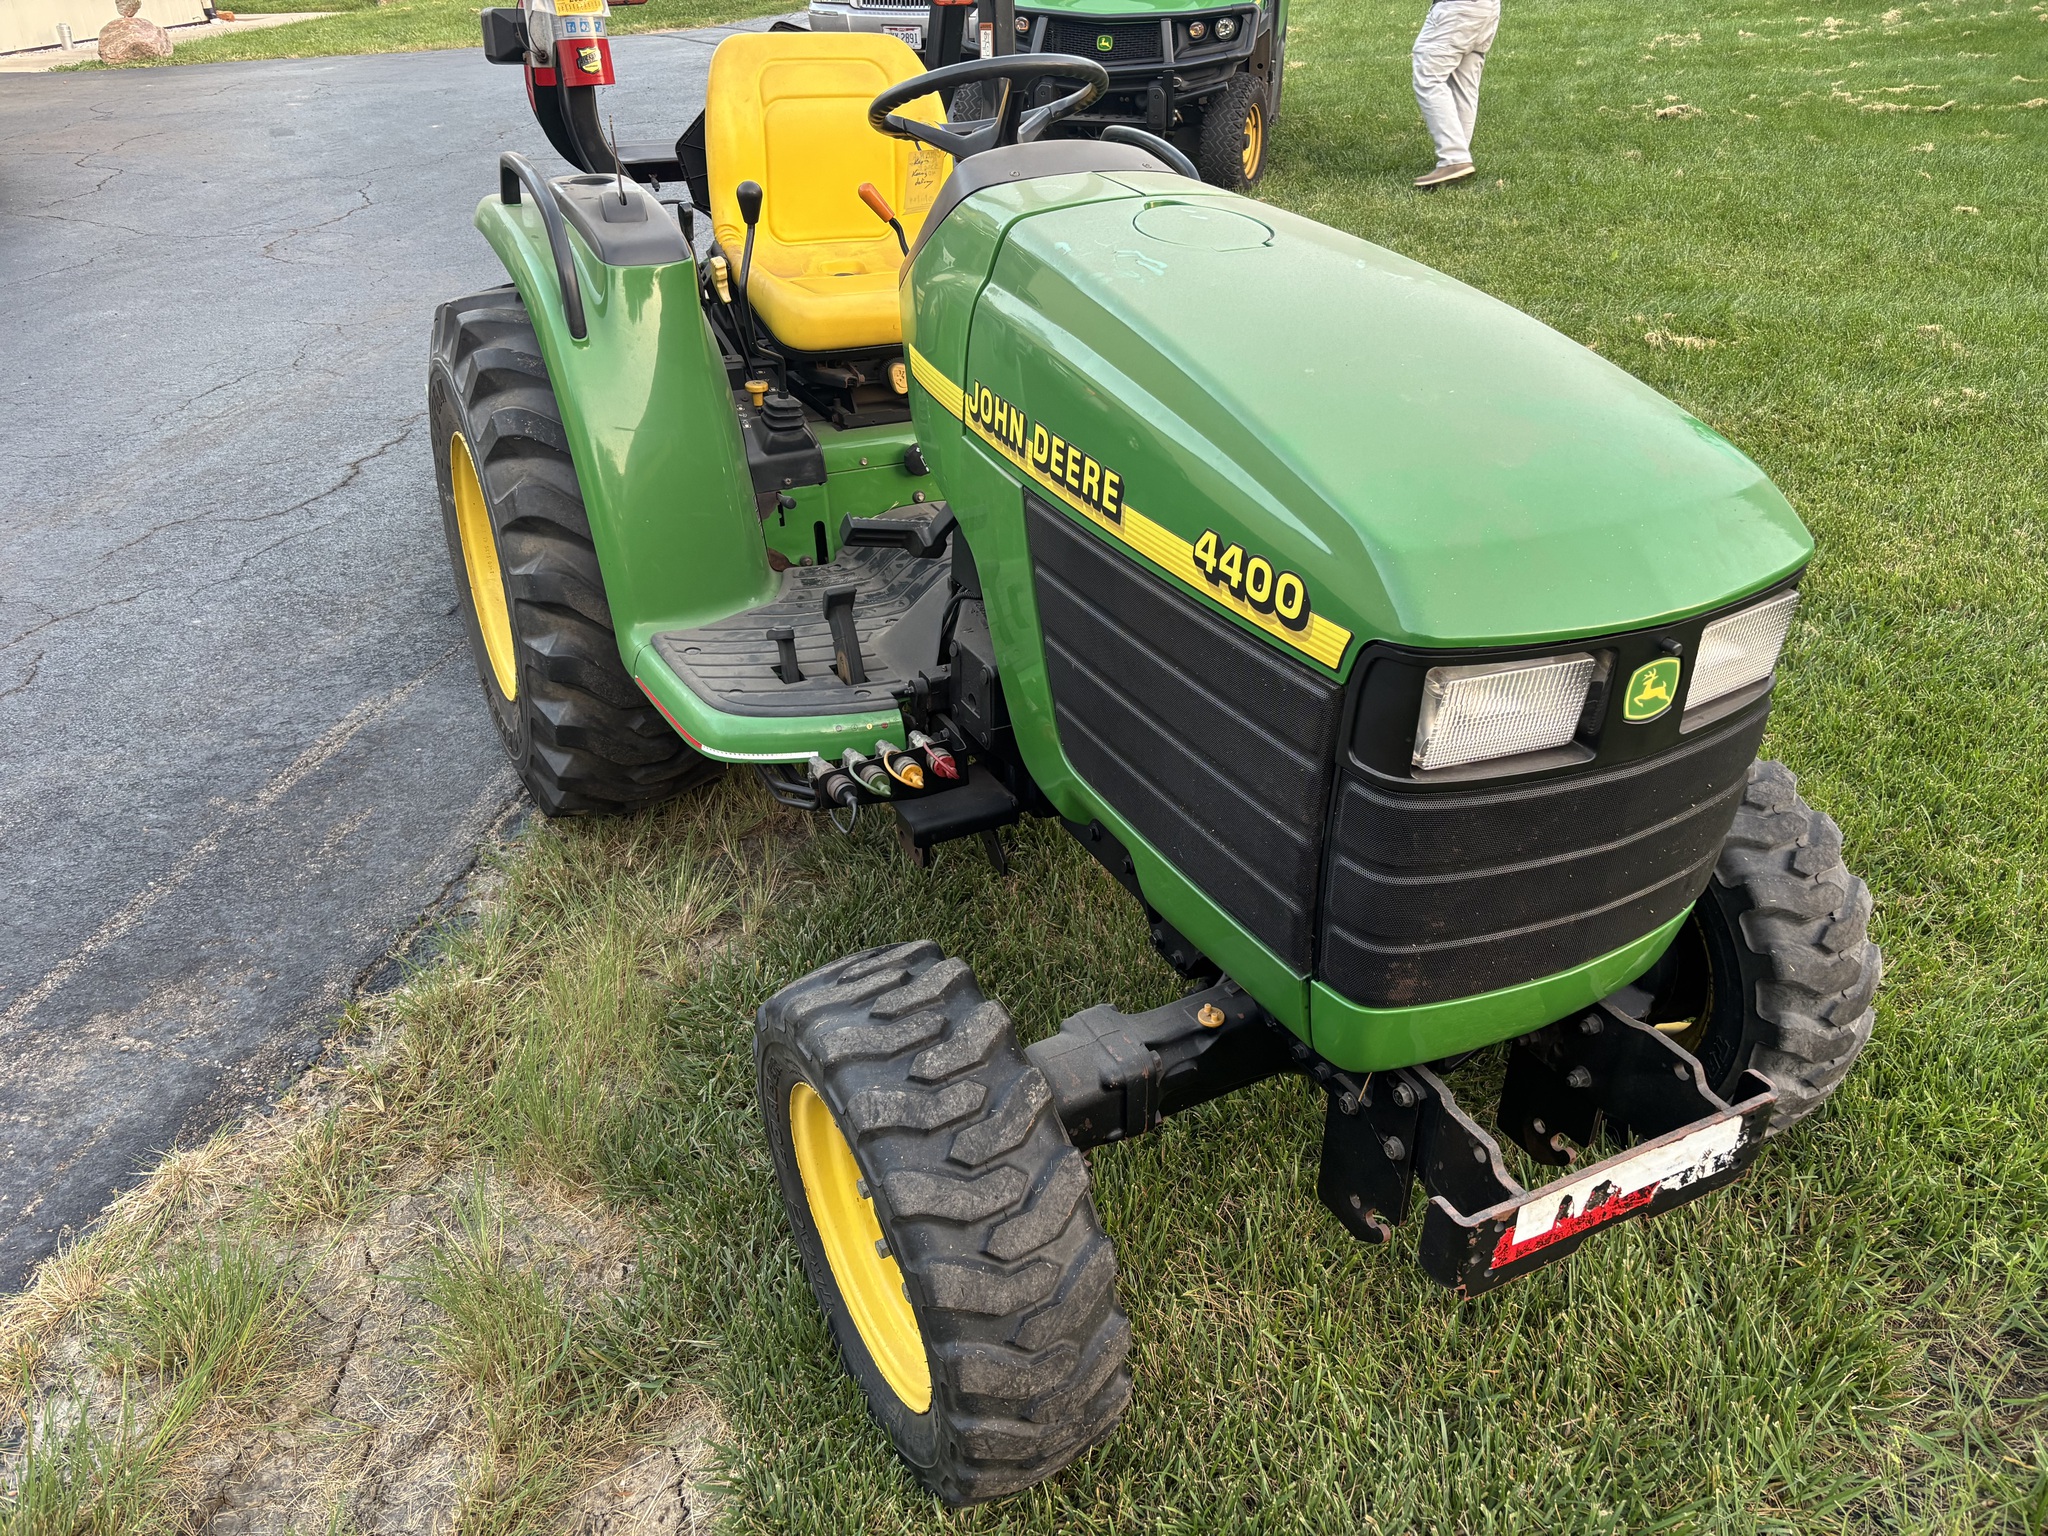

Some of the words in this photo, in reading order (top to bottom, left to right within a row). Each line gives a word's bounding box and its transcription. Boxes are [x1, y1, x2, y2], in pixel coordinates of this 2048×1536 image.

[900, 32, 918, 44] 2891
[968, 380, 1026, 454] JOHN
[1031, 421, 1124, 521] DEERE
[1193, 528, 1309, 627] 4400
